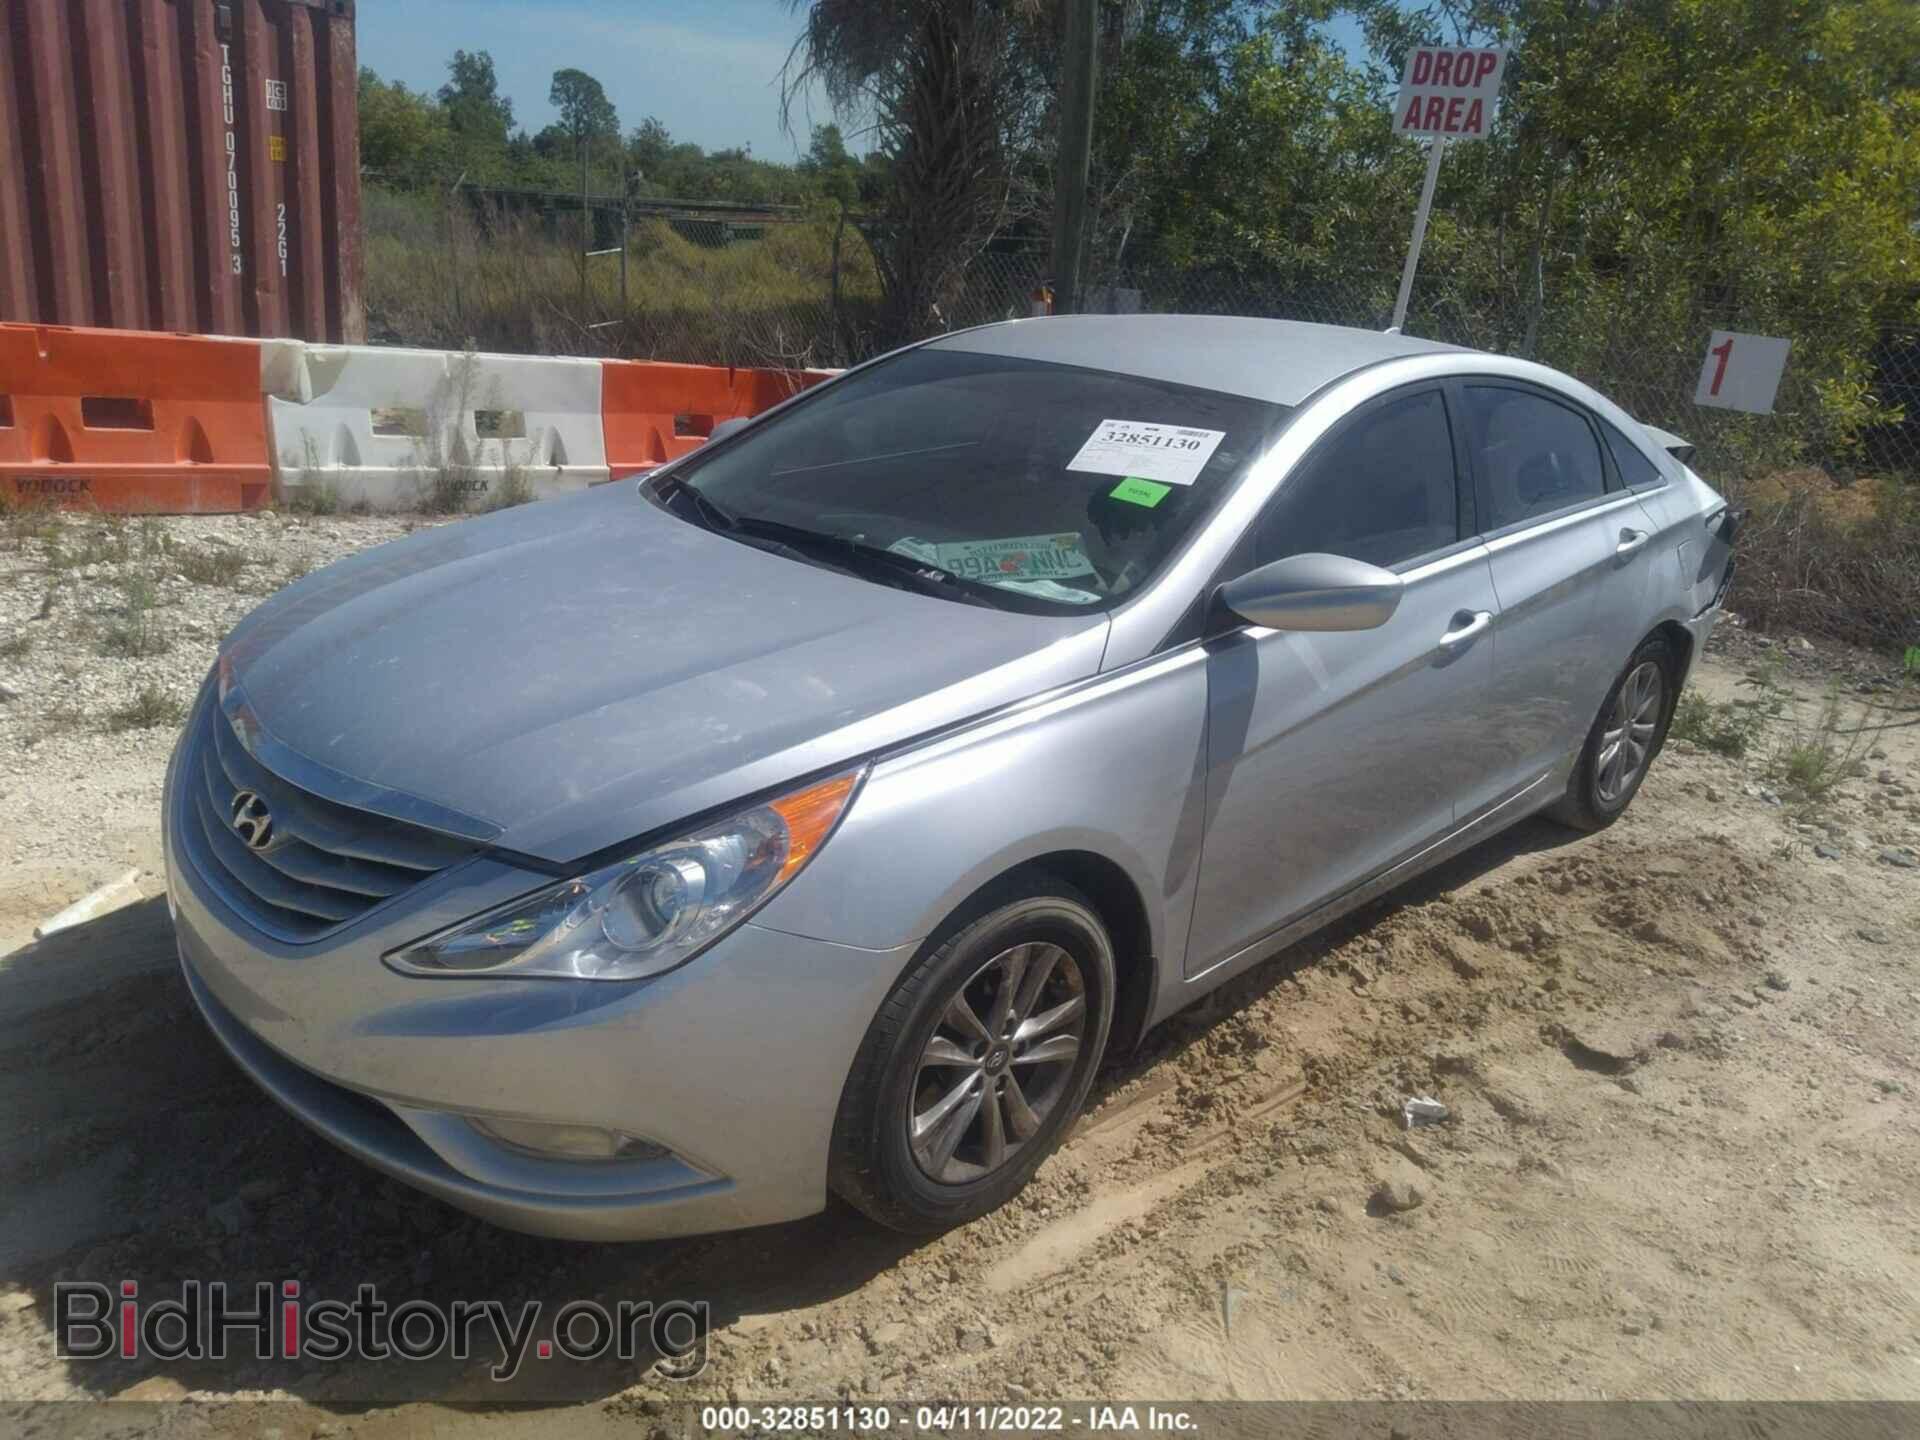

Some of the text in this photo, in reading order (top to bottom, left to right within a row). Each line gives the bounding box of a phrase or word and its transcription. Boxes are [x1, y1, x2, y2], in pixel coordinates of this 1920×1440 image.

[1411, 50, 1497, 88] DROP
[1402, 95, 1483, 133] AREA
[219, 44, 234, 125] TGHU
[232, 254, 242, 275] 3
[277, 203, 288, 277] 22G1
[1710, 336, 1733, 396] 1
[1101, 431, 1201, 451] 32851130
